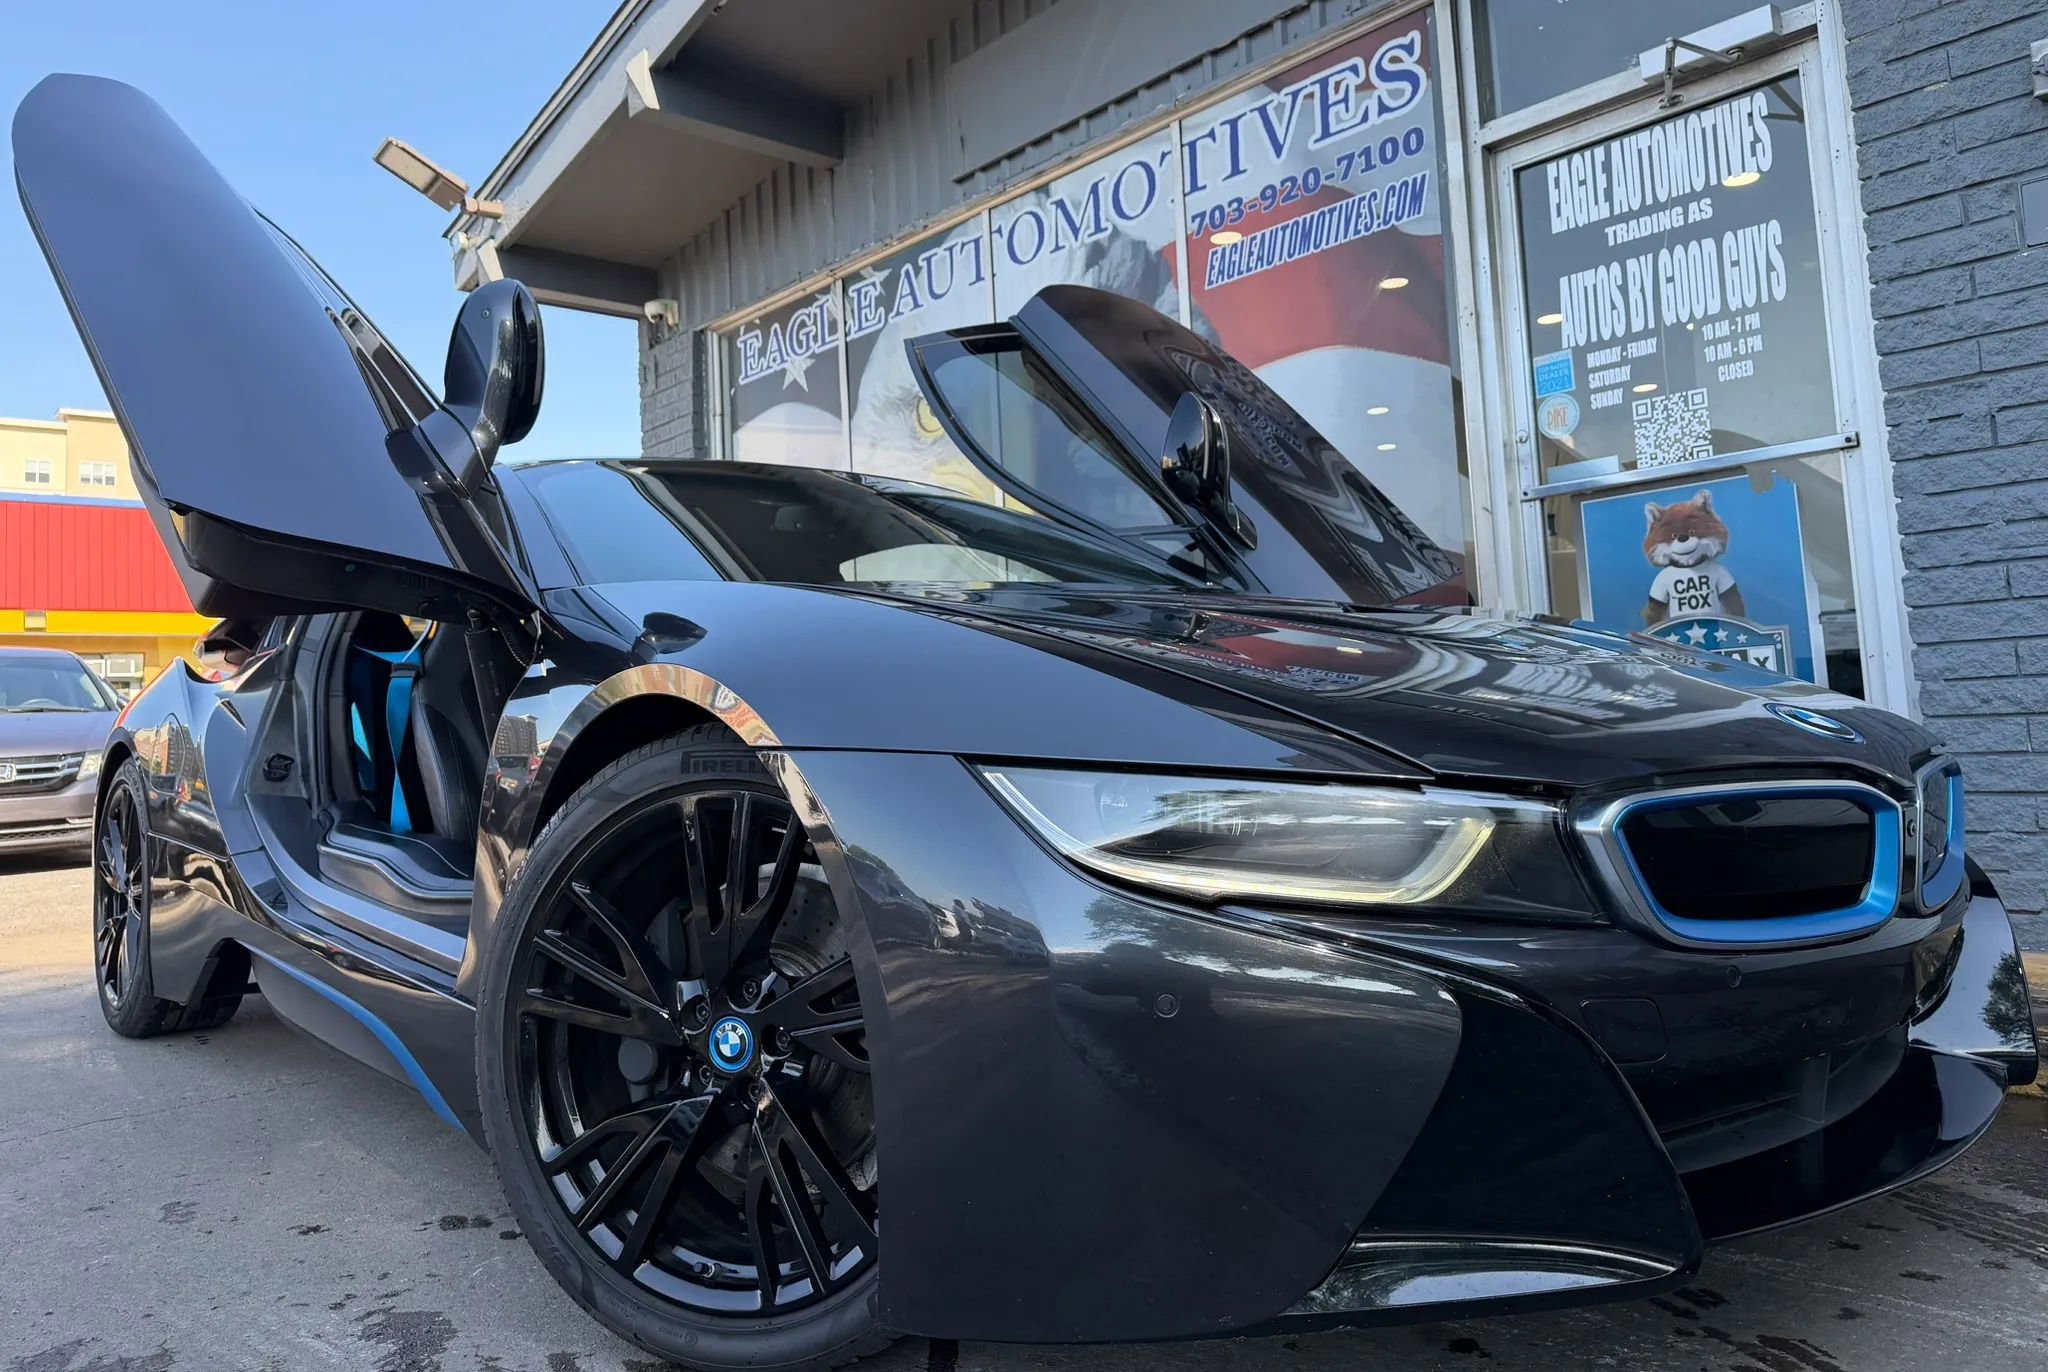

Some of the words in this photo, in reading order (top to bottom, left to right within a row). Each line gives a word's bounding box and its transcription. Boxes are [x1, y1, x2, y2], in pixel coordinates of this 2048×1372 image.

[1547, 148, 1611, 235] EAGLE
[1610, 91, 1773, 216] AUTOMOTIVES
[1191, 127, 1425, 239] 703-920-7100
[738, 281, 885, 385] EAGLE
[890, 31, 1427, 322] AUTOMOTIVES
[1604, 206, 1684, 247] TRADING
[1687, 198, 1713, 223] AS
[1205, 171, 1429, 289] EAGLEAUTOMOTIVES.COM
[1559, 261, 1627, 349] AUTOS
[1626, 253, 1656, 334] BY
[1657, 237, 1722, 327] GOOD
[1722, 219, 1788, 310] GUYS
[1702, 323, 1714, 341] 10
[1714, 319, 1730, 339] AM
[1744, 312, 1760, 331] PM
[1586, 345, 1621, 369] MONDAY
[1627, 337, 1657, 359] FRIDAY
[1704, 345, 1716, 362] 10
[1717, 341, 1732, 360] AM
[1738, 338, 1746, 355] 6
[1746, 334, 1763, 353] PM
[1588, 364, 1631, 389] SATURDAY
[1718, 359, 1754, 382] CLOSED
[1590, 388, 1623, 410] SUNDAY
[1673, 574, 1710, 595] CAR
[1678, 592, 1712, 612] FOX
[715, 1023, 744, 1039] BMW
